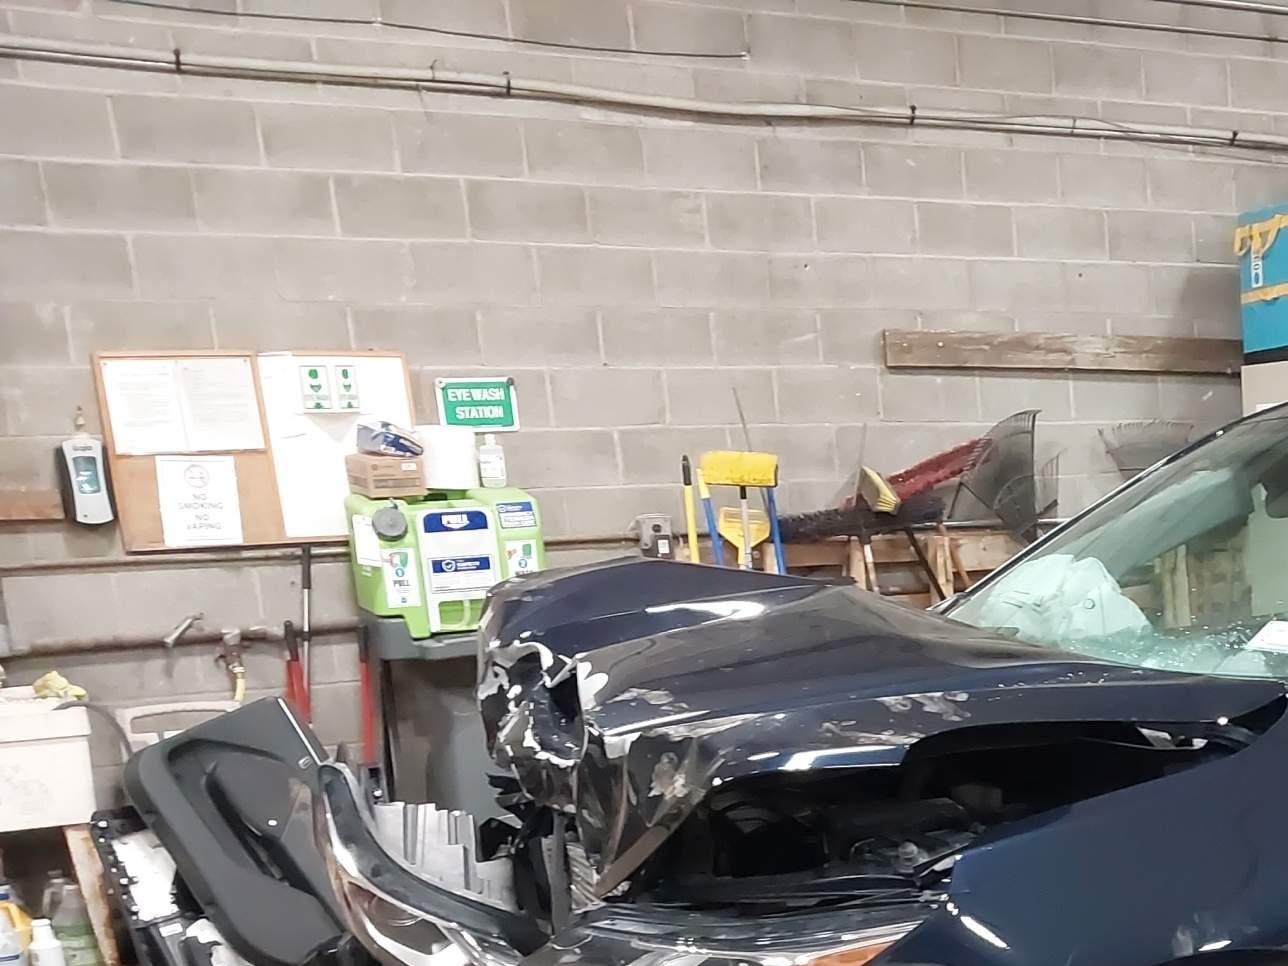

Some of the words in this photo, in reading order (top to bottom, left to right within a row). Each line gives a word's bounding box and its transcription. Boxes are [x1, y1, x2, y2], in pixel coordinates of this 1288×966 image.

[447, 389, 471, 402] EYE
[471, 388, 505, 401] WASH
[455, 406, 504, 419] STATION
[192, 493, 208, 501] NO
[178, 502, 223, 510] SMOKING
